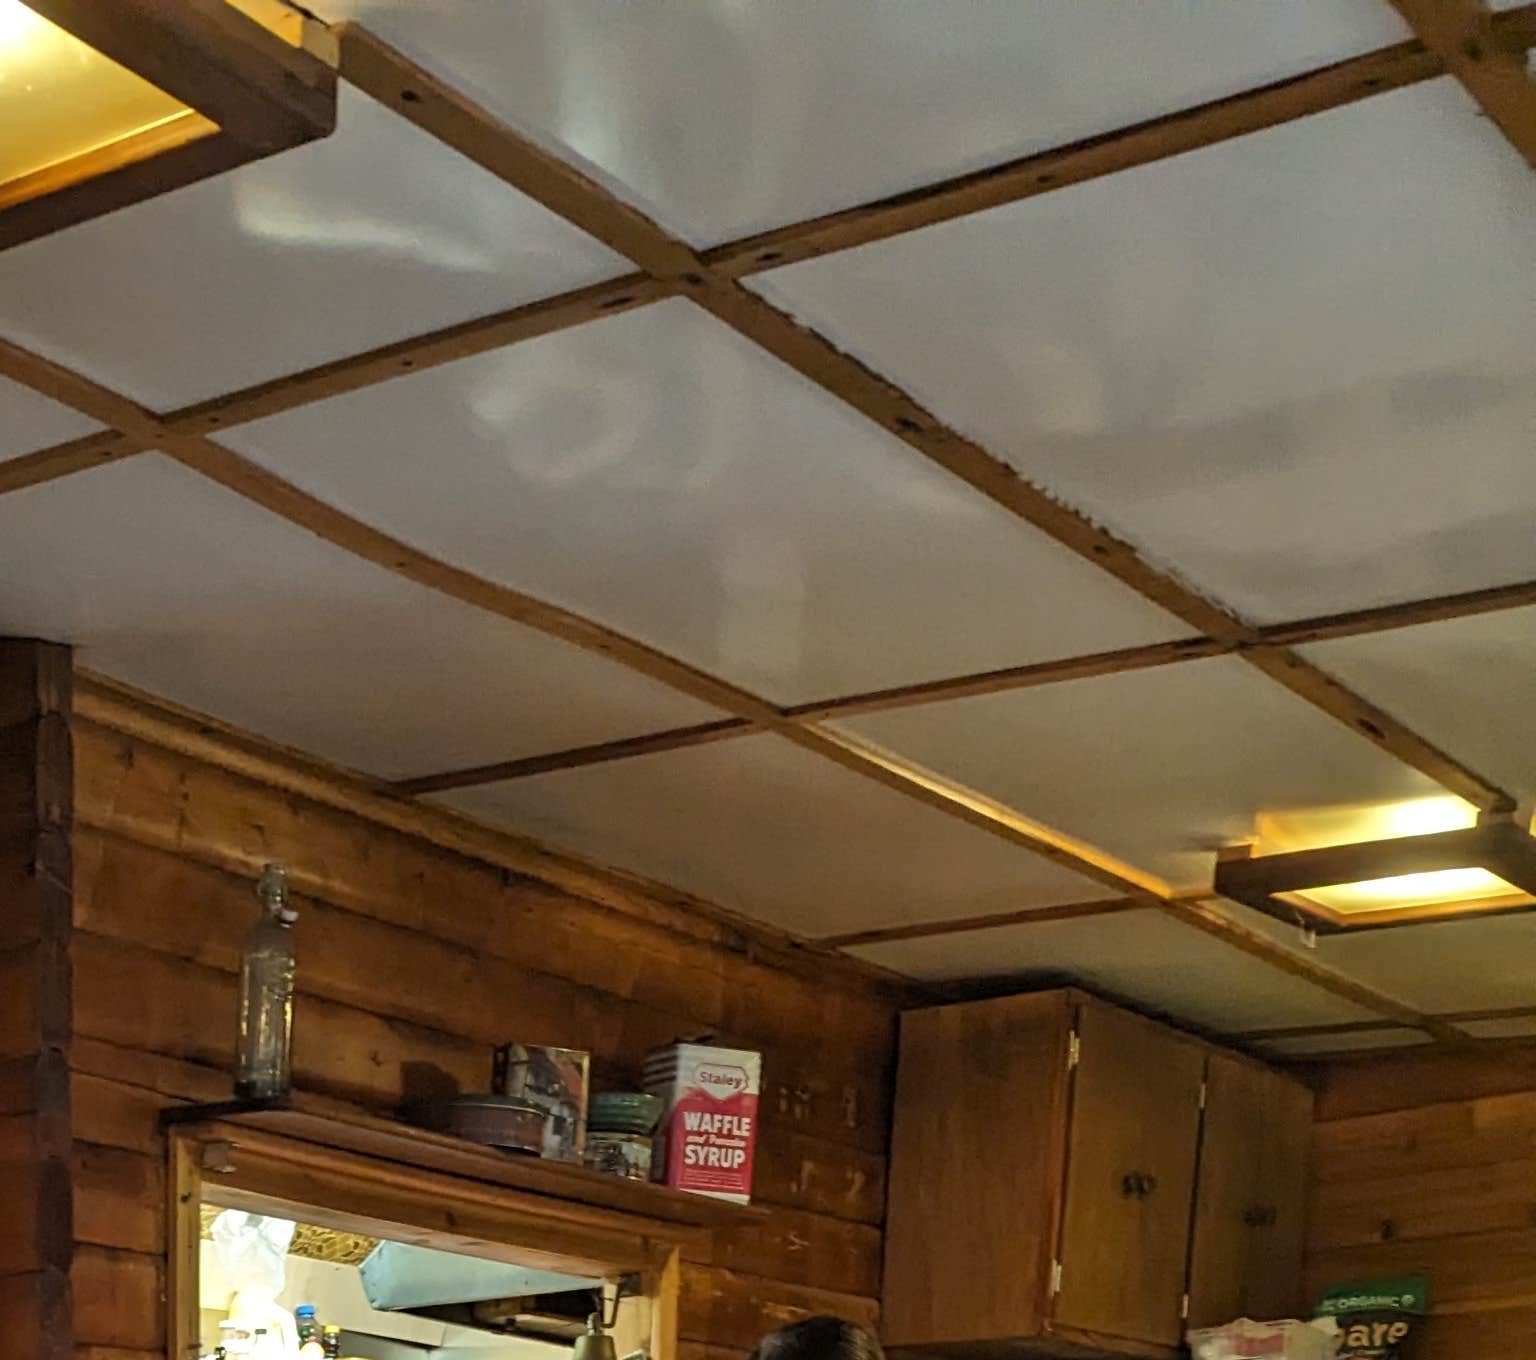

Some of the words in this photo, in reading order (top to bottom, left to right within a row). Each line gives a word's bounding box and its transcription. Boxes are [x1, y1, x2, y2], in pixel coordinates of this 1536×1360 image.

[699, 1071, 743, 1089] Staley
[683, 1111, 752, 1137] WAFFLE
[683, 1144, 746, 1169] SYRUP
